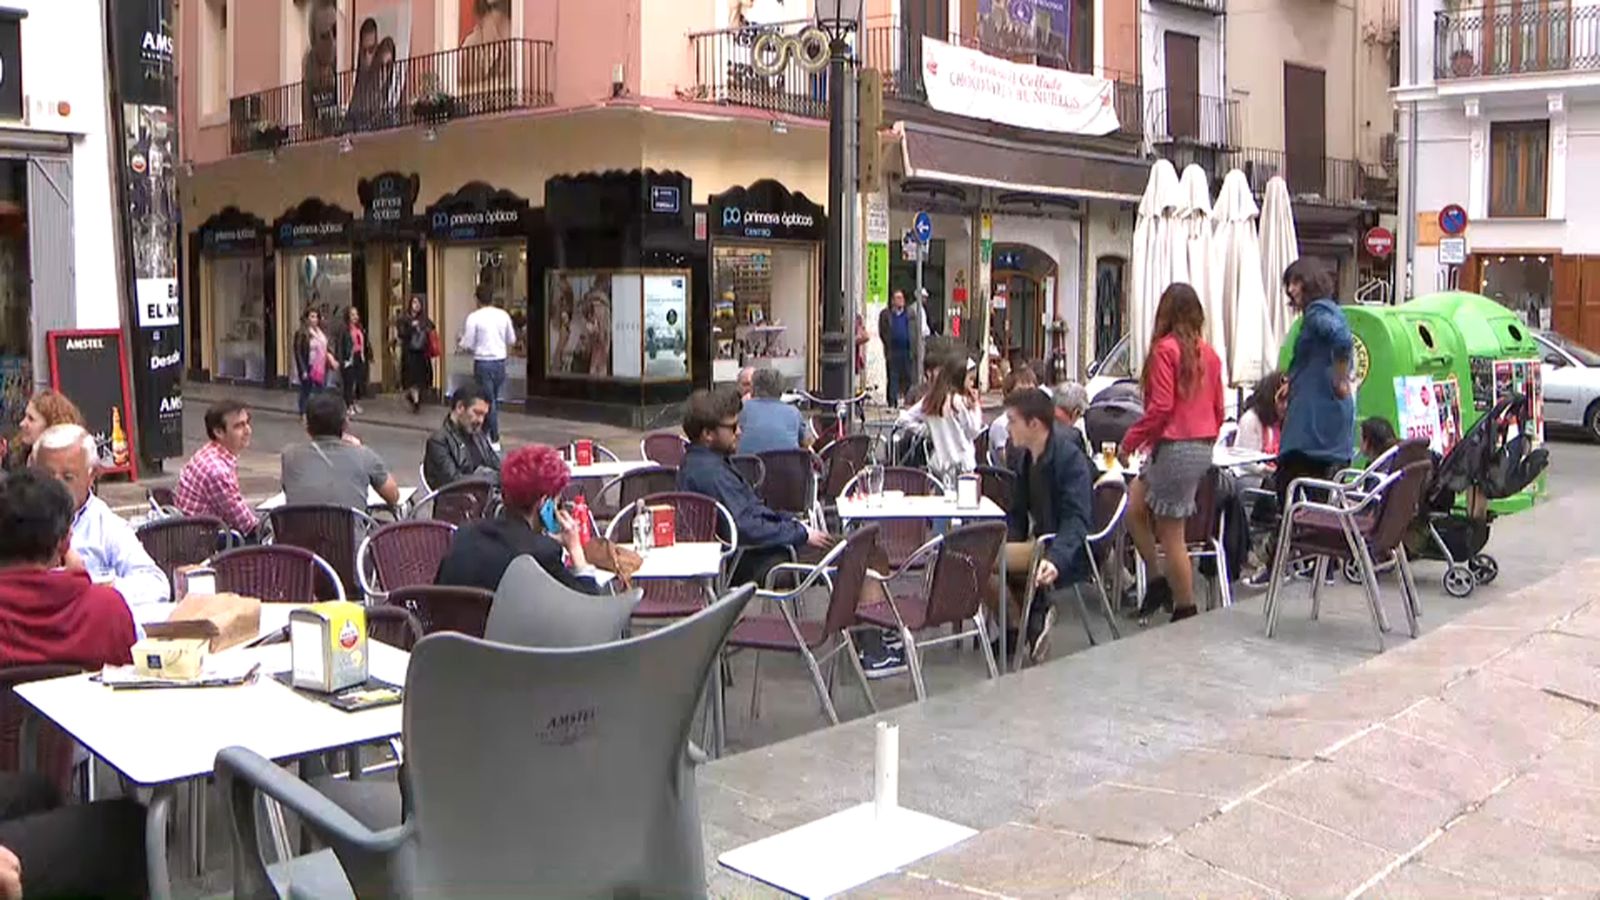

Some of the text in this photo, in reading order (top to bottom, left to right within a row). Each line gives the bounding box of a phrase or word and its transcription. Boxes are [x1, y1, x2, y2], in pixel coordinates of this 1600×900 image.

[450, 212, 484, 227] primera
[743, 211, 780, 226] primera
[781, 211, 814, 228] ópticos
[147, 303, 164, 319] EL
[66, 338, 104, 350] AMSTEL
